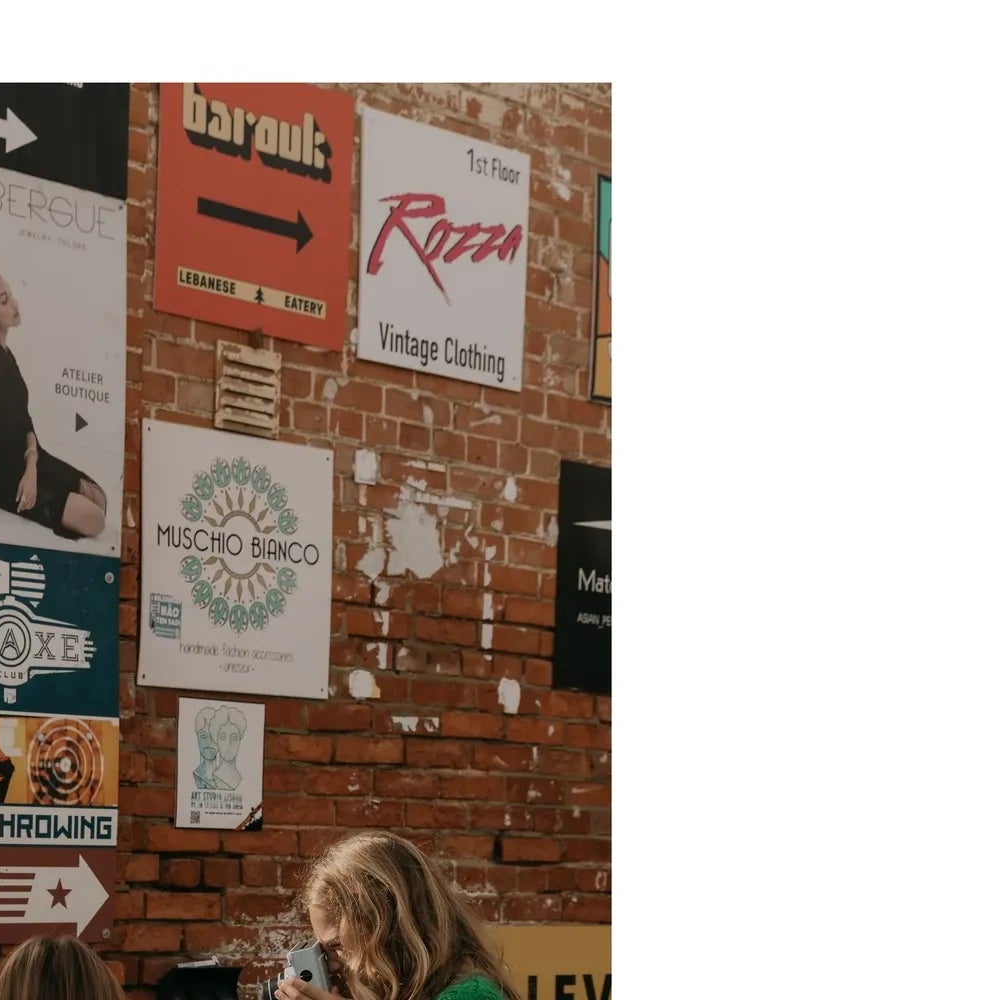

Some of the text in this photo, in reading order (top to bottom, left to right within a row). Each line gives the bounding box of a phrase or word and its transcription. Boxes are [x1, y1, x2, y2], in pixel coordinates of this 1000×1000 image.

[183, 83, 329, 177] barouk
[467, 148, 521, 184] 1st Floor
[179, 269, 324, 316] LEBANESE EATERY
[379, 321, 505, 383] Vintage Clothing
[55, 382, 110, 403] BOUTIQUE
[62, 367, 104, 385] ATELIER
[157, 523, 320, 566] MUSCHIO BIANCO
[578, 567, 611, 594] Mat
